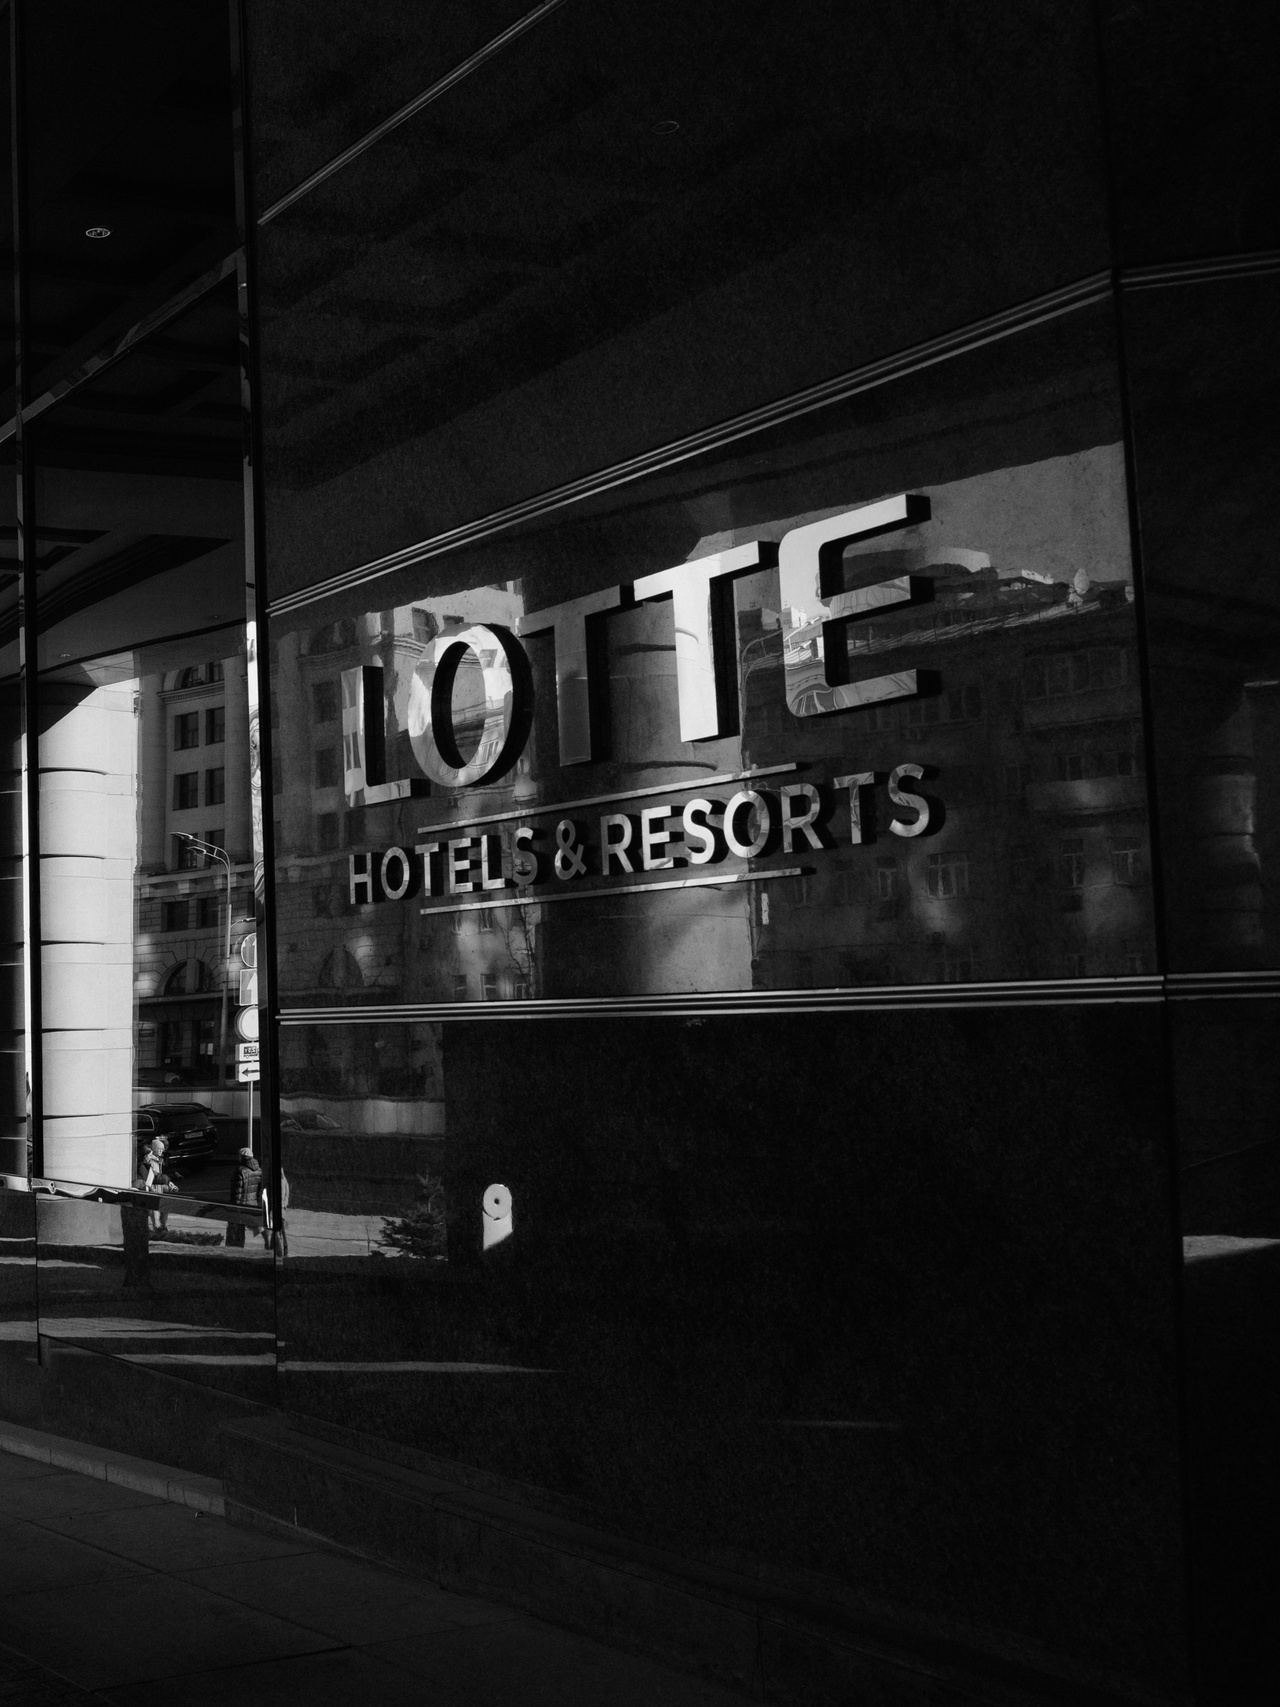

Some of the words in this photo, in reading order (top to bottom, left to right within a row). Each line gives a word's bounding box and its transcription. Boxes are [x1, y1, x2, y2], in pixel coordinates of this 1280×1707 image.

[341, 494, 920, 808] LOTTE
[349, 827, 539, 904] HOTELS
[554, 819, 587, 880] &
[600, 763, 931, 876] RESORTS
